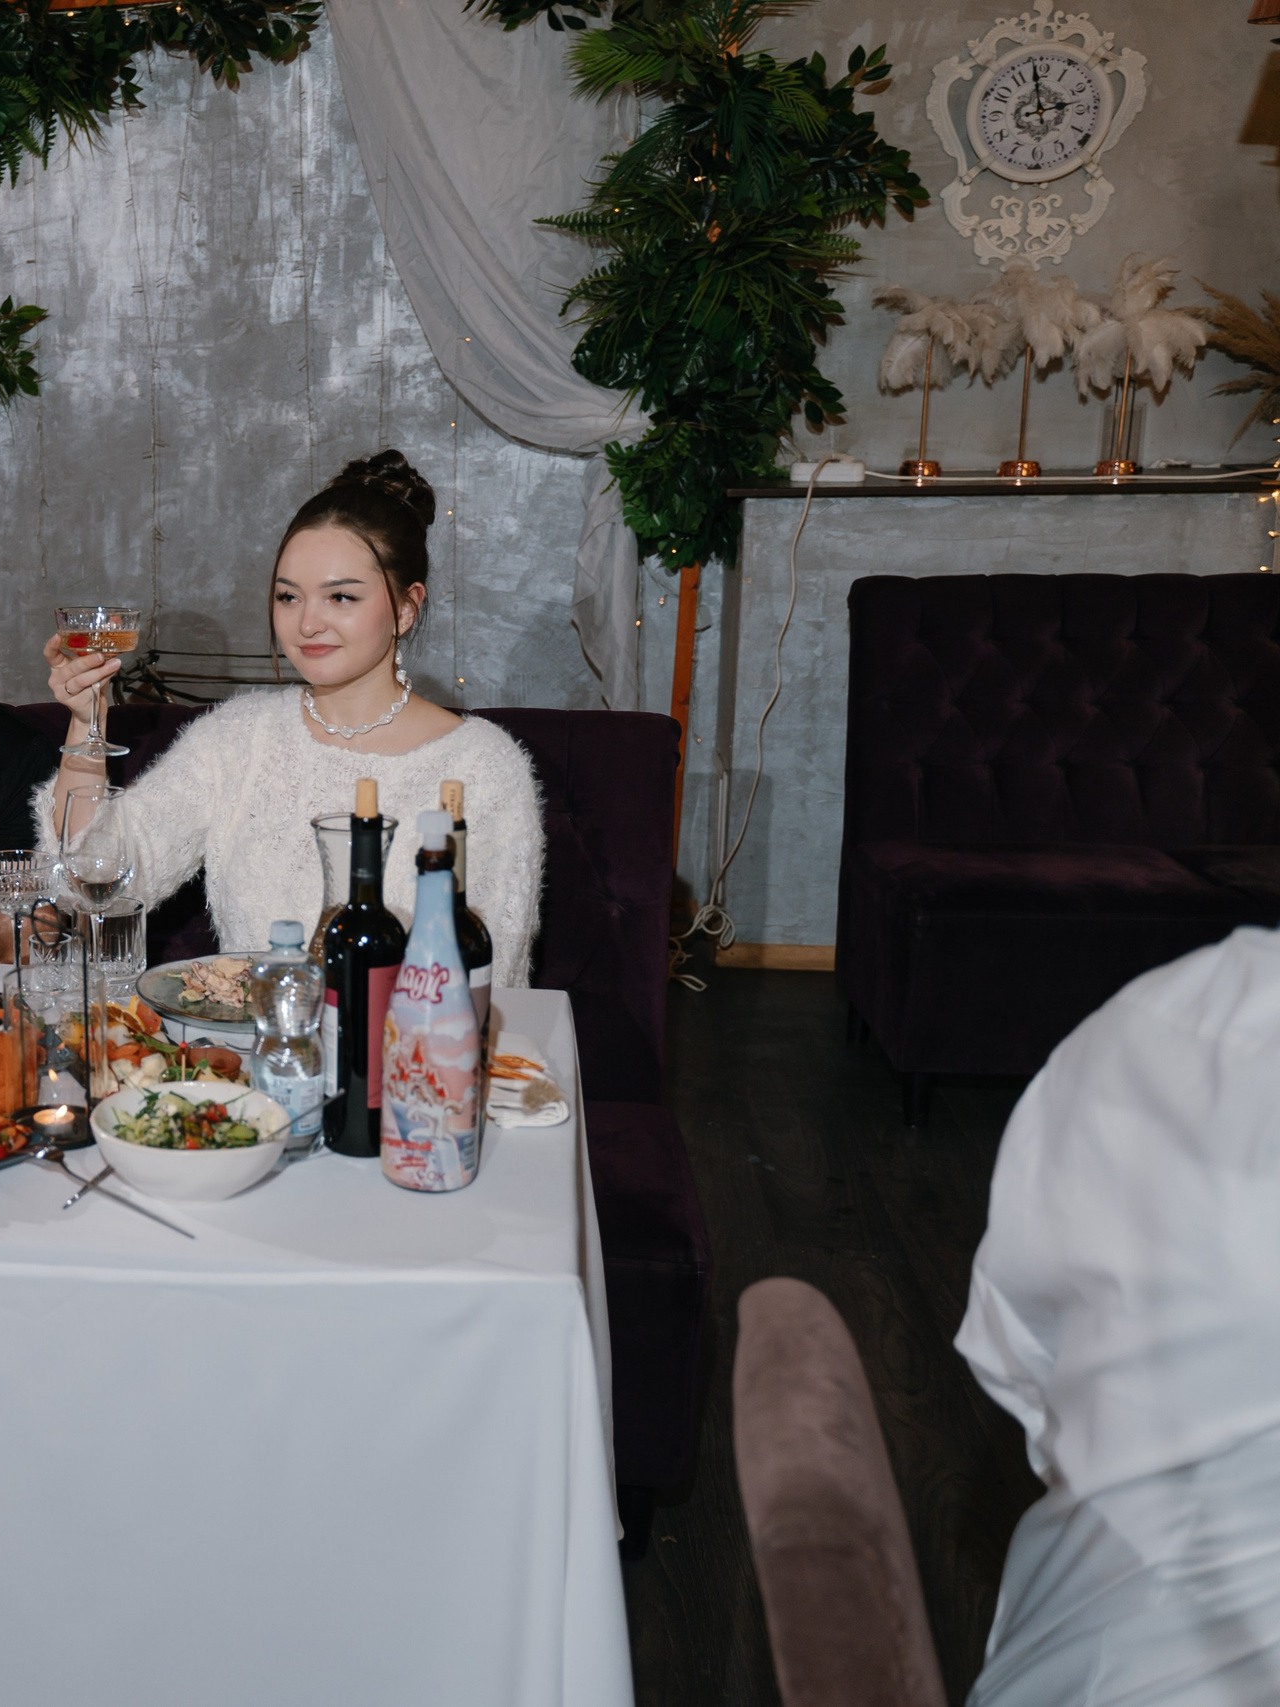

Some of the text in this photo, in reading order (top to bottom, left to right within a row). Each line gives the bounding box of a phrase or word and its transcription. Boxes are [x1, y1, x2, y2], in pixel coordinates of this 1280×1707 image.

[1011, 71, 1027, 87] 11
[1057, 69, 1068, 82] 1
[994, 86, 1012, 104] 10
[1070, 82, 1086, 96] 2
[988, 110, 1003, 122] 9
[993, 128, 1009, 143] 8
[1010, 141, 1025, 155] 7
[1031, 146, 1043, 161] 6
[1054, 139, 1065, 154] 5
